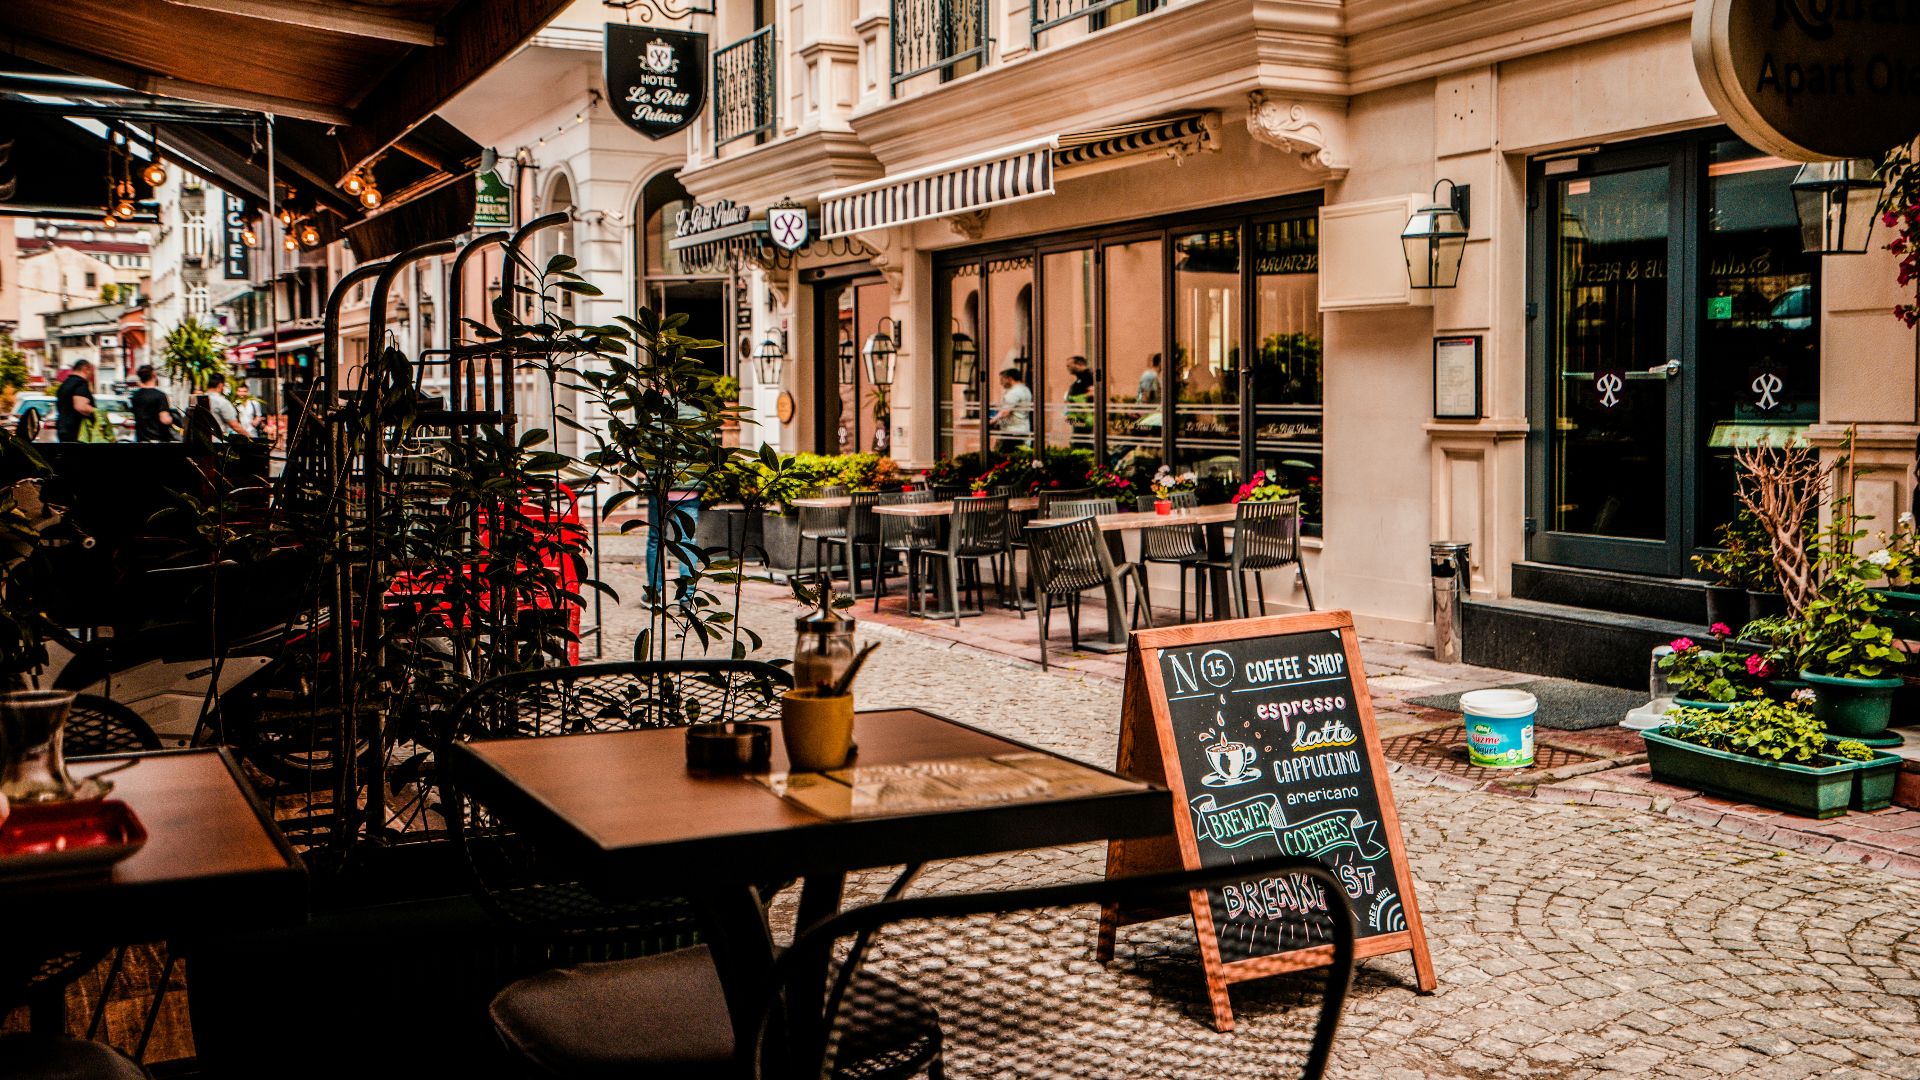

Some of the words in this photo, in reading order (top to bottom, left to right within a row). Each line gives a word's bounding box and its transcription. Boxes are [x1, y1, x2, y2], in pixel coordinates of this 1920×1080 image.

[641, 74, 678, 88] HOTEL
[1756, 53, 1855, 107] Apart
[625, 86, 651, 104] Le
[651, 88, 690, 107] Petit
[631, 104, 684, 123] Palace
[227, 196, 244, 275] HOTEL
[674, 208, 691, 237] Le
[1267, 423, 1279, 434] Le
[1207, 659, 1226, 678] 15
[1245, 655, 1303, 684] COFFEE
[1307, 652, 1344, 676] SHOP
[1256, 696, 1347, 733] espresso
[1291, 719, 1356, 751] latte
[1273, 750, 1361, 784] CAPPUCCINO
[1286, 786, 1359, 806] americano
[1207, 801, 1271, 841] BREWED
[1283, 815, 1351, 856] COFFEES
[1222, 864, 1376, 921] BREAKFST
[1369, 903, 1379, 928] FREE
